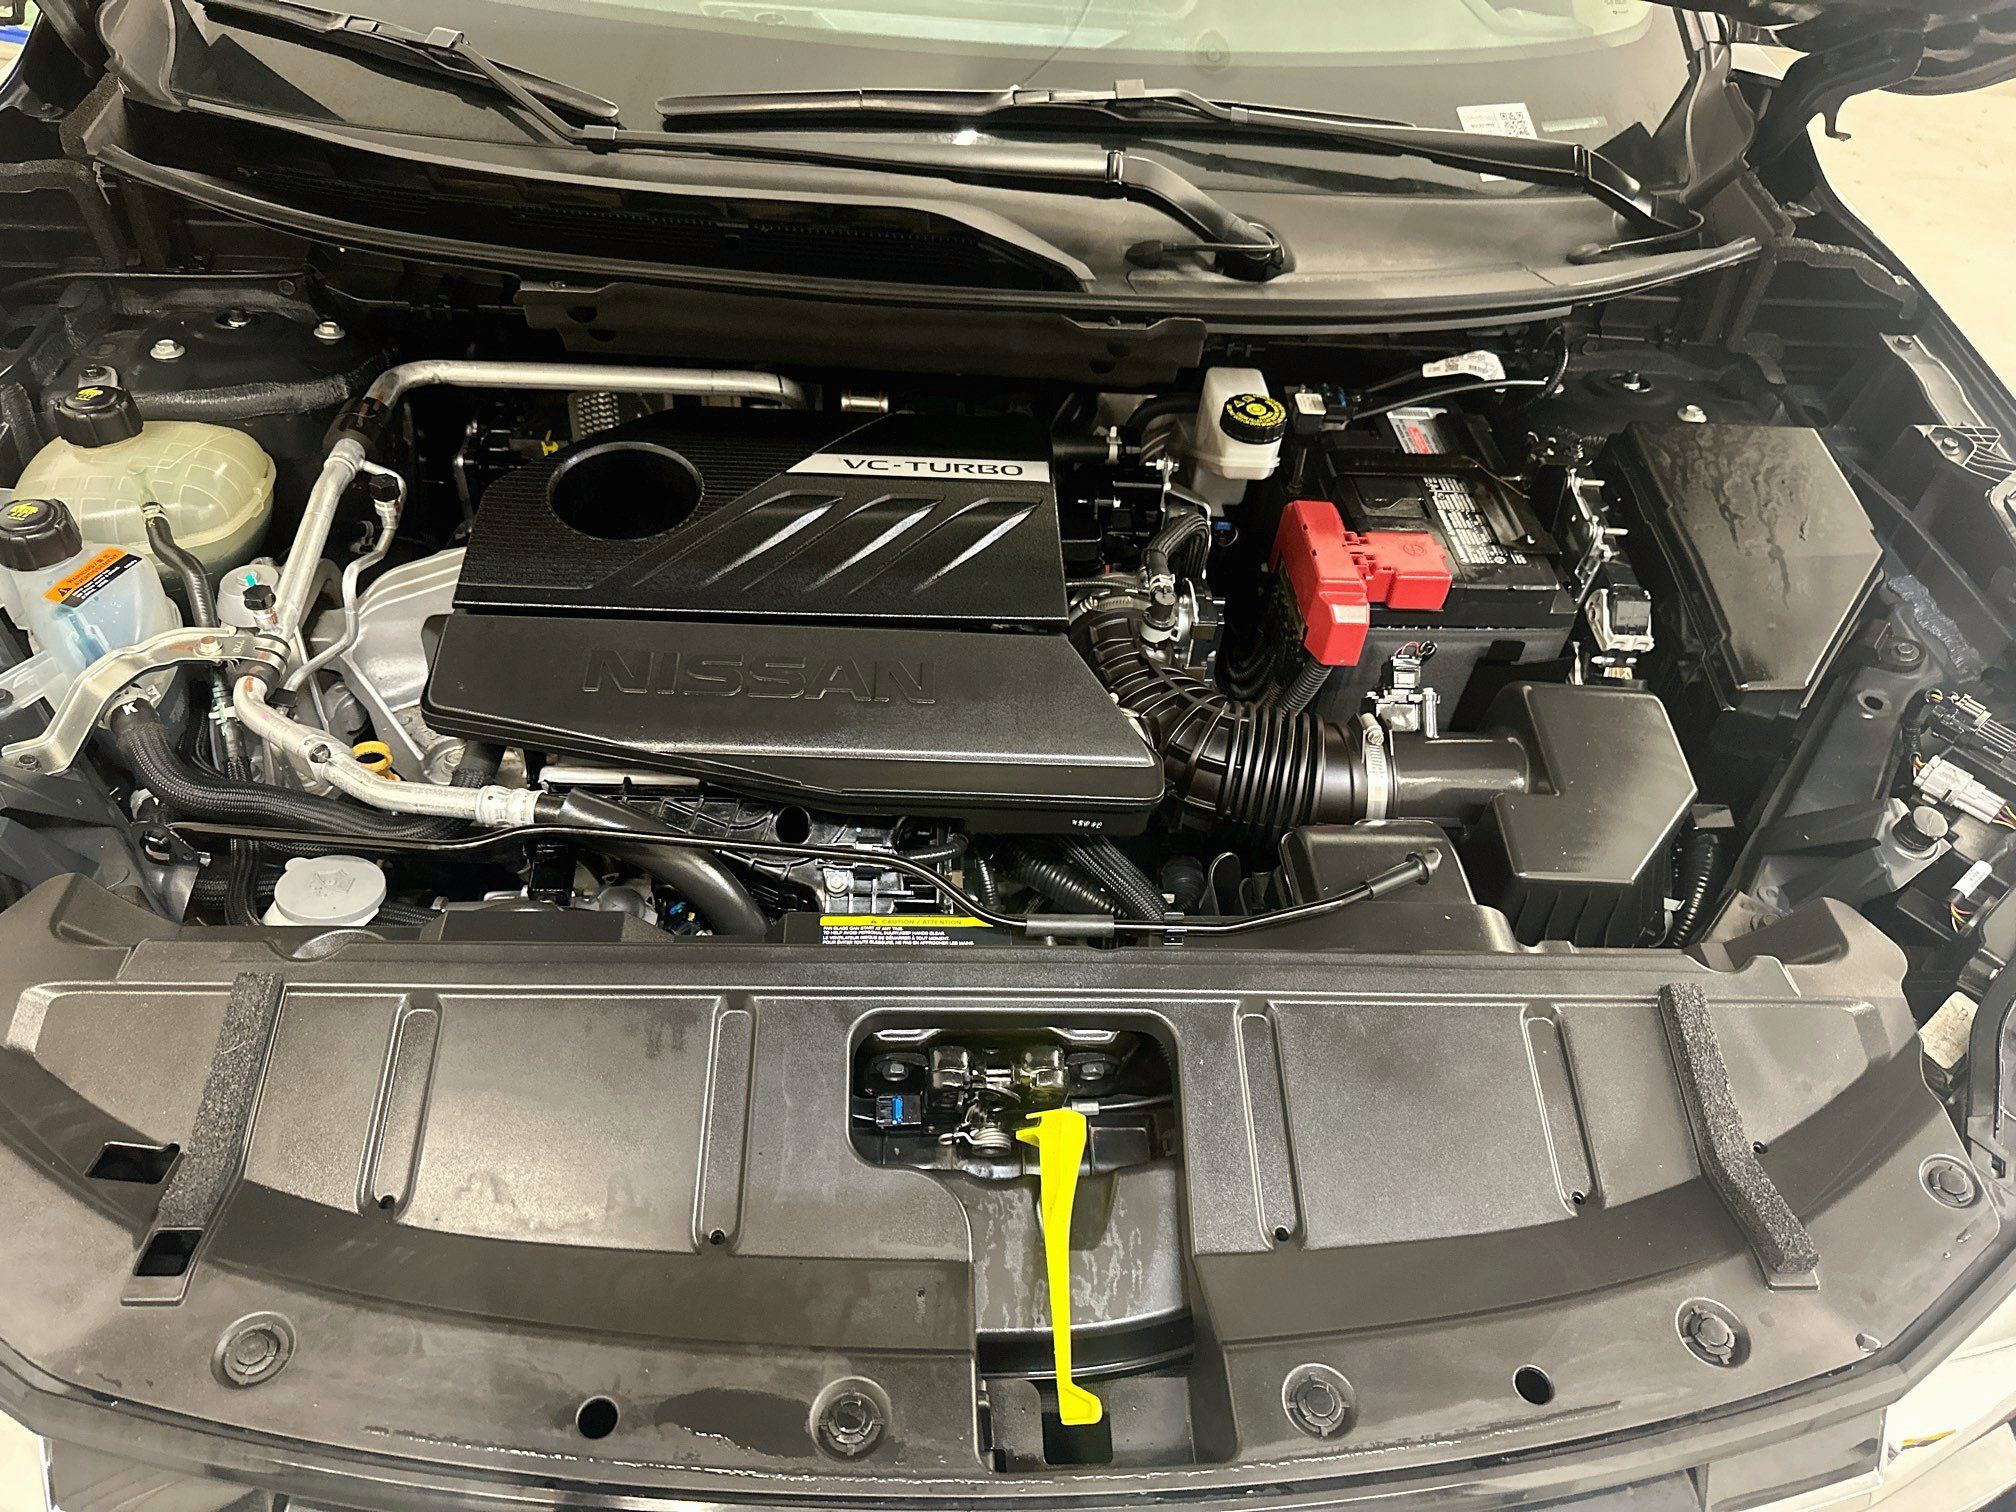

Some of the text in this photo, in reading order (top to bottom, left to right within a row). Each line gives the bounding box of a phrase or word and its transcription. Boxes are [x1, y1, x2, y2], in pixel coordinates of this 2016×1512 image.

[842, 458, 1023, 476] VC-TURBO
[582, 650, 936, 704] NISSAN
[122, 703, 139, 715] K
